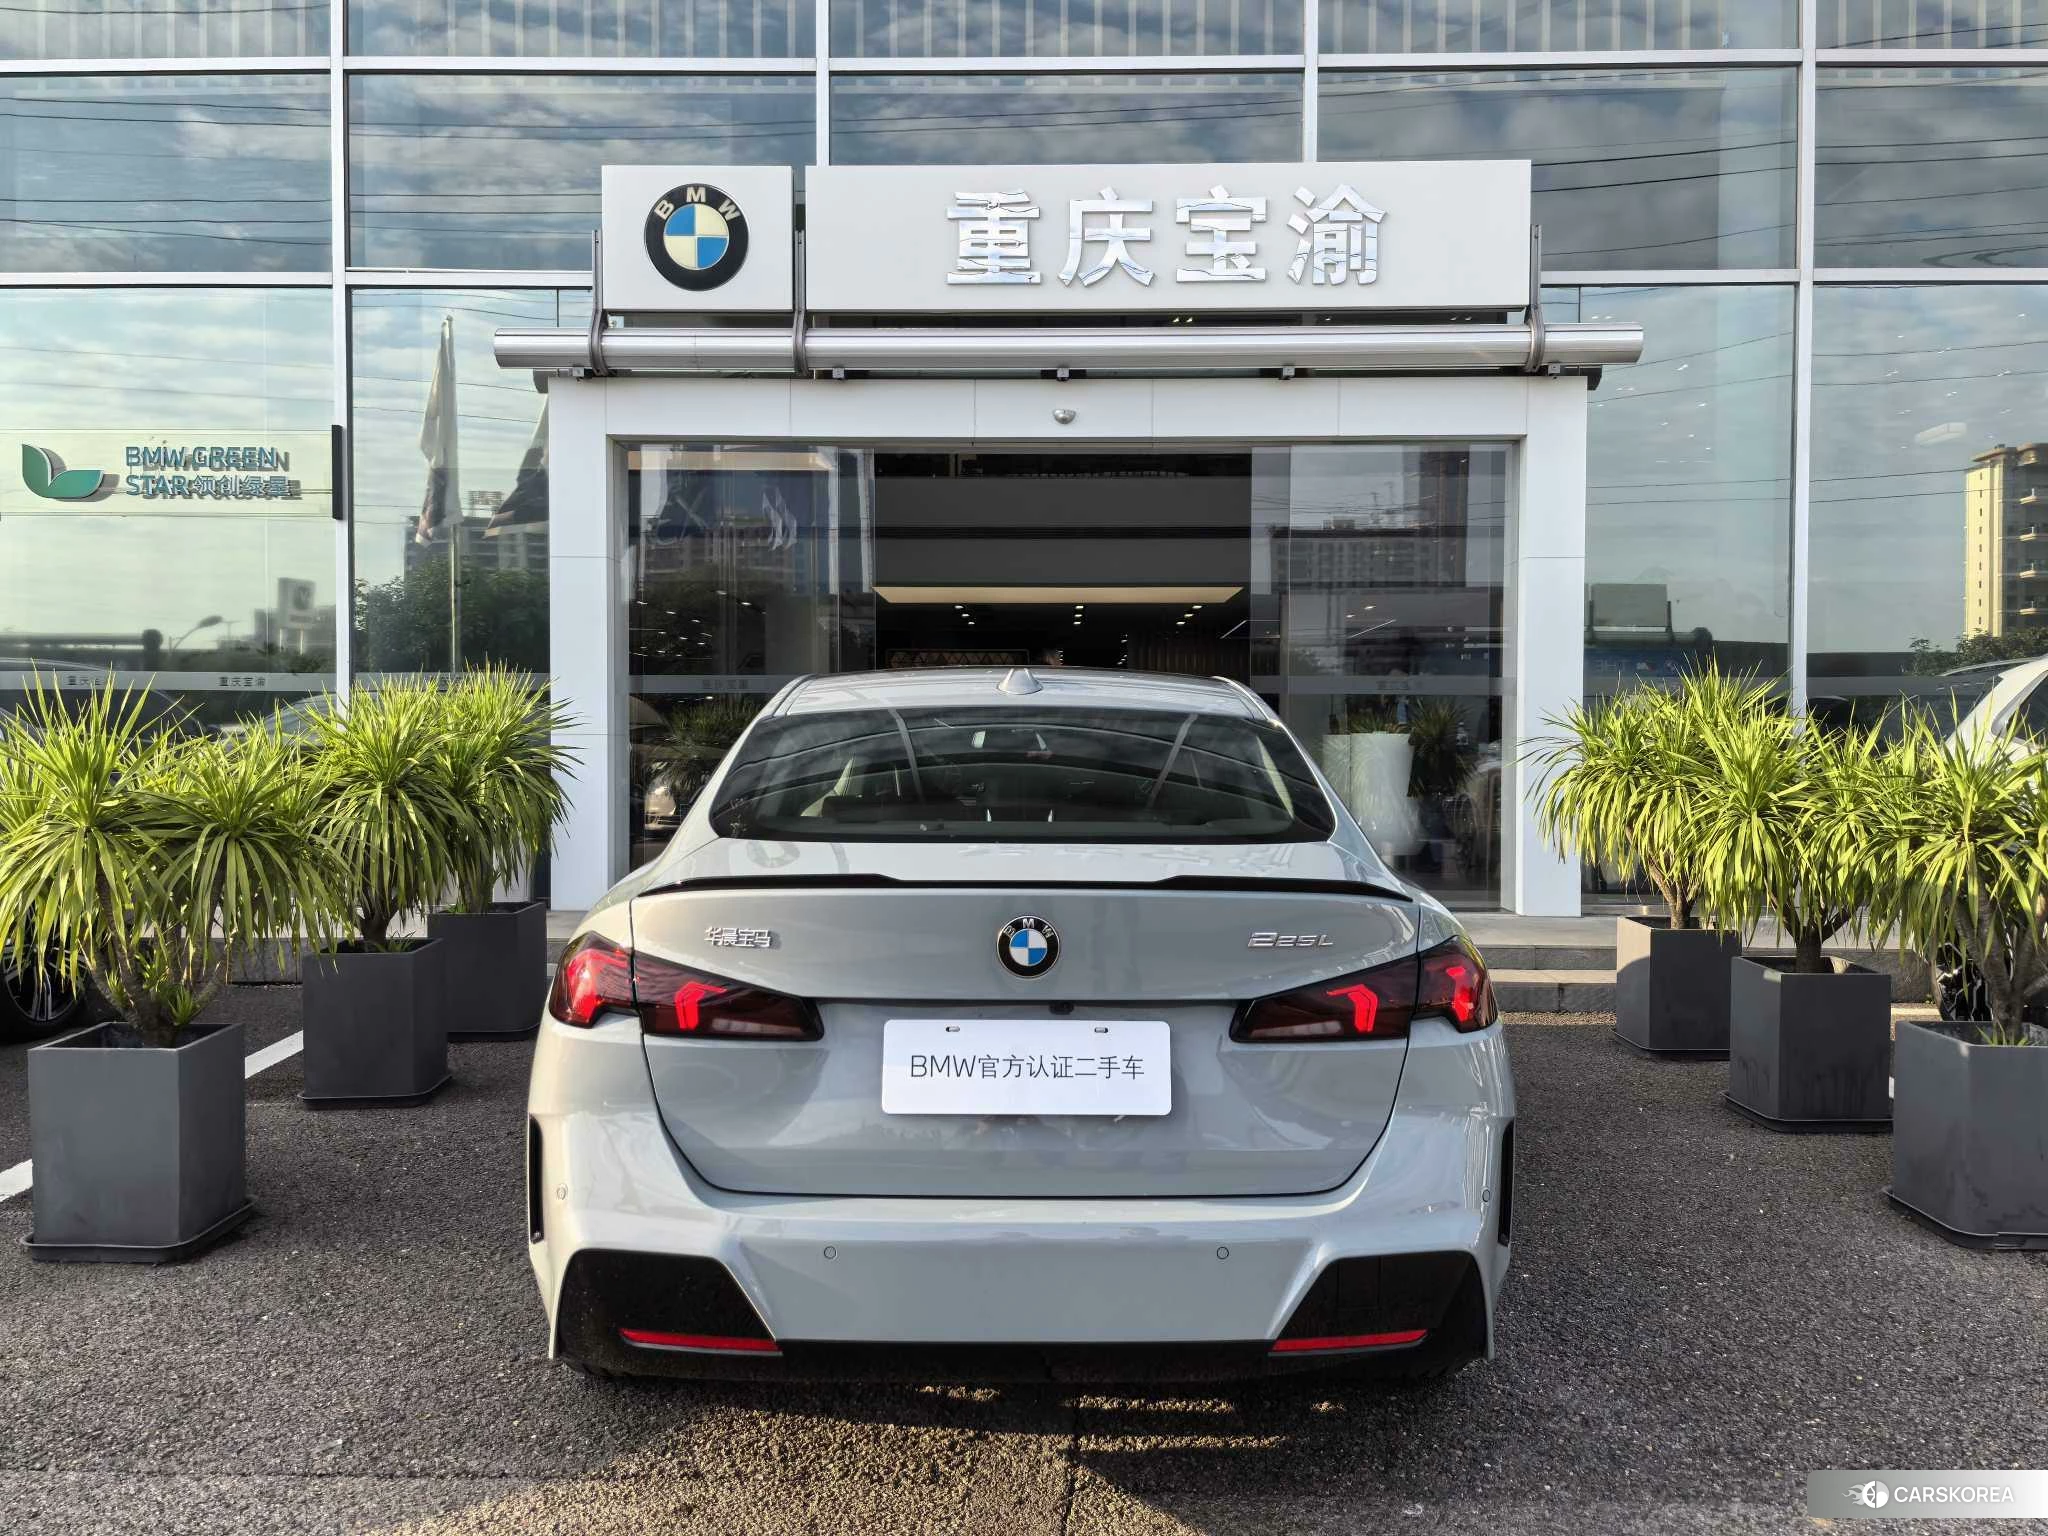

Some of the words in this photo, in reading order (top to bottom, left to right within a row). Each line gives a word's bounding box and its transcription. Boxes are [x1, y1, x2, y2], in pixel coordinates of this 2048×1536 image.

[654, 186, 741, 221] BMW
[946, 183, 1388, 287] 重庆宝渝
[126, 446, 186, 467] BMW
[192, 446, 277, 468] GREEN
[126, 474, 189, 496] STAR
[704, 925, 771, 947] 华晨宝马
[1003, 918, 1055, 939] BMW
[1247, 932, 1333, 947] 225L
[910, 1054, 1145, 1080] BMW官方认证二手车
